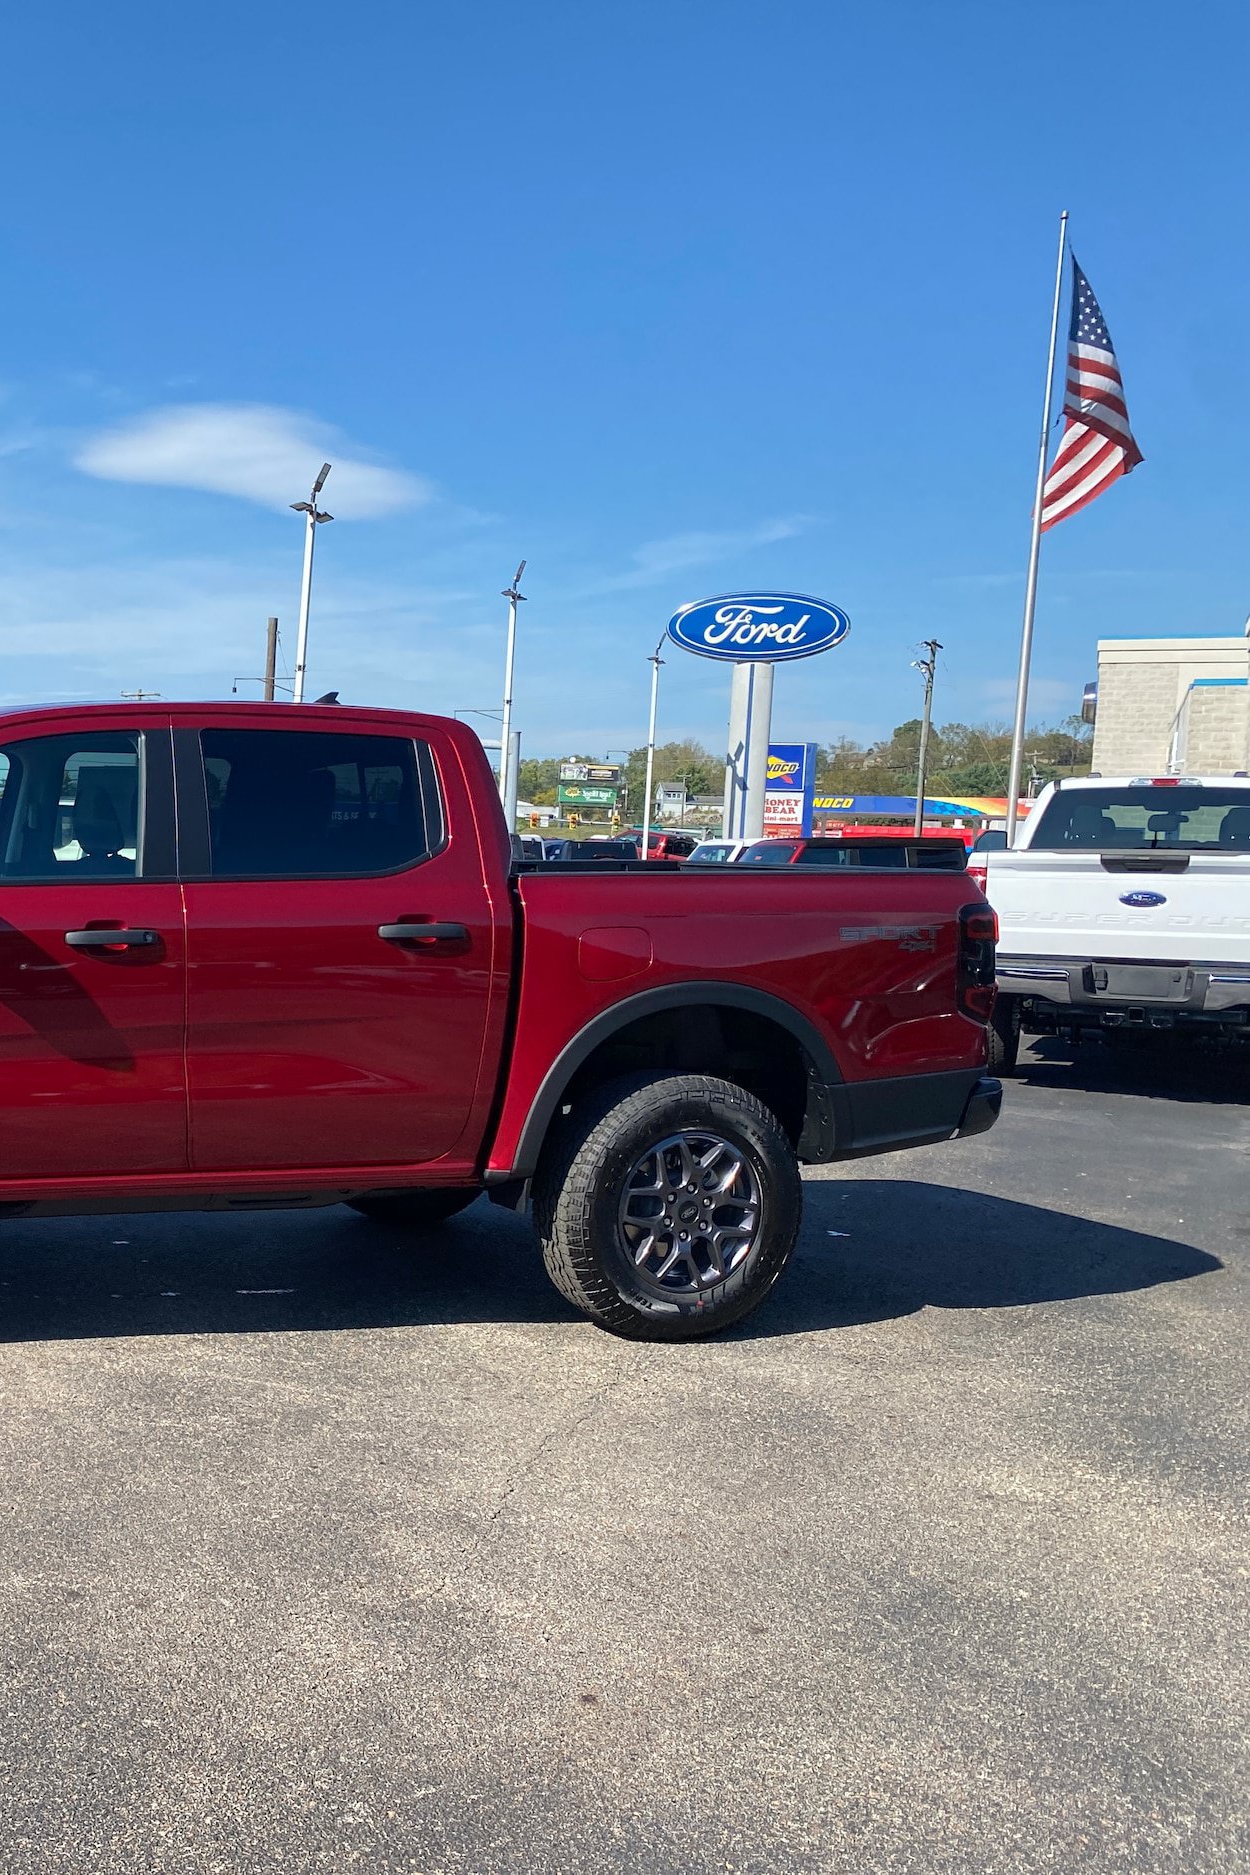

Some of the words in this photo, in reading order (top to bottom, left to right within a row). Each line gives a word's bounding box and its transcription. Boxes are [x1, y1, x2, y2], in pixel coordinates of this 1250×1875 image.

[703, 604, 811, 645] Ford
[765, 806, 796, 814] BEAR
[1002, 911, 1155, 926] SUPER
[839, 925, 945, 941] SPORT
